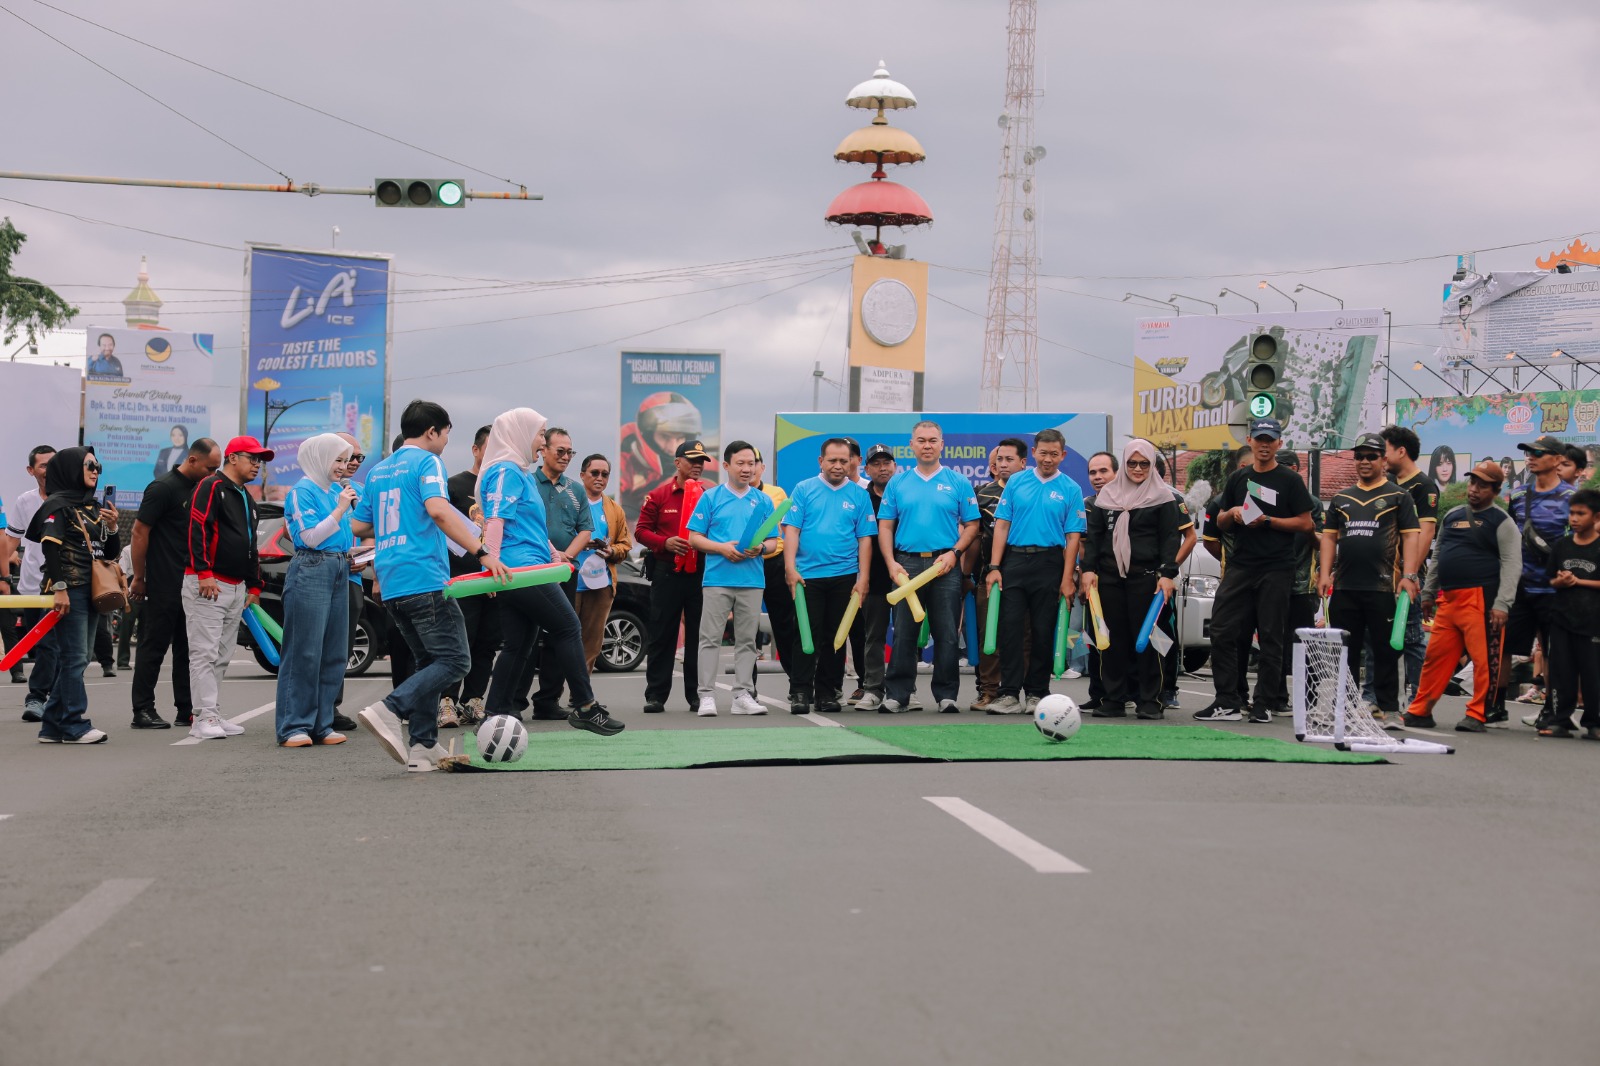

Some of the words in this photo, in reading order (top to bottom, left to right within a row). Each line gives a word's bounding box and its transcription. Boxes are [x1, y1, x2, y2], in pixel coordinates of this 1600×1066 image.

[1558, 281, 1599, 294] WALIKOTA
[327, 314, 355, 325] ICE
[281, 341, 315, 355] TASTE
[318, 338, 341, 352] THE
[257, 355, 308, 371] COOLEST
[310, 350, 378, 369] FLAVORS
[660, 360, 683, 373] TIDAK
[684, 360, 715, 374] PERNAH
[872, 370, 904, 379] ADIPURA
[112, 388, 148, 400] Selamat
[148, 389, 183, 404] Datang
[1138, 382, 1202, 415] TURBO
[161, 403, 183, 414] SURYA
[184, 404, 207, 415] PALOH
[121, 413, 144, 421] Umum
[146, 414, 167, 422] Partai
[168, 415, 198, 424] NasDem
[1541, 420, 1567, 433] FEST
[1578, 424, 1595, 432] TMI
[945, 446, 986, 459] HADIR
[378, 487, 401, 537] 18
